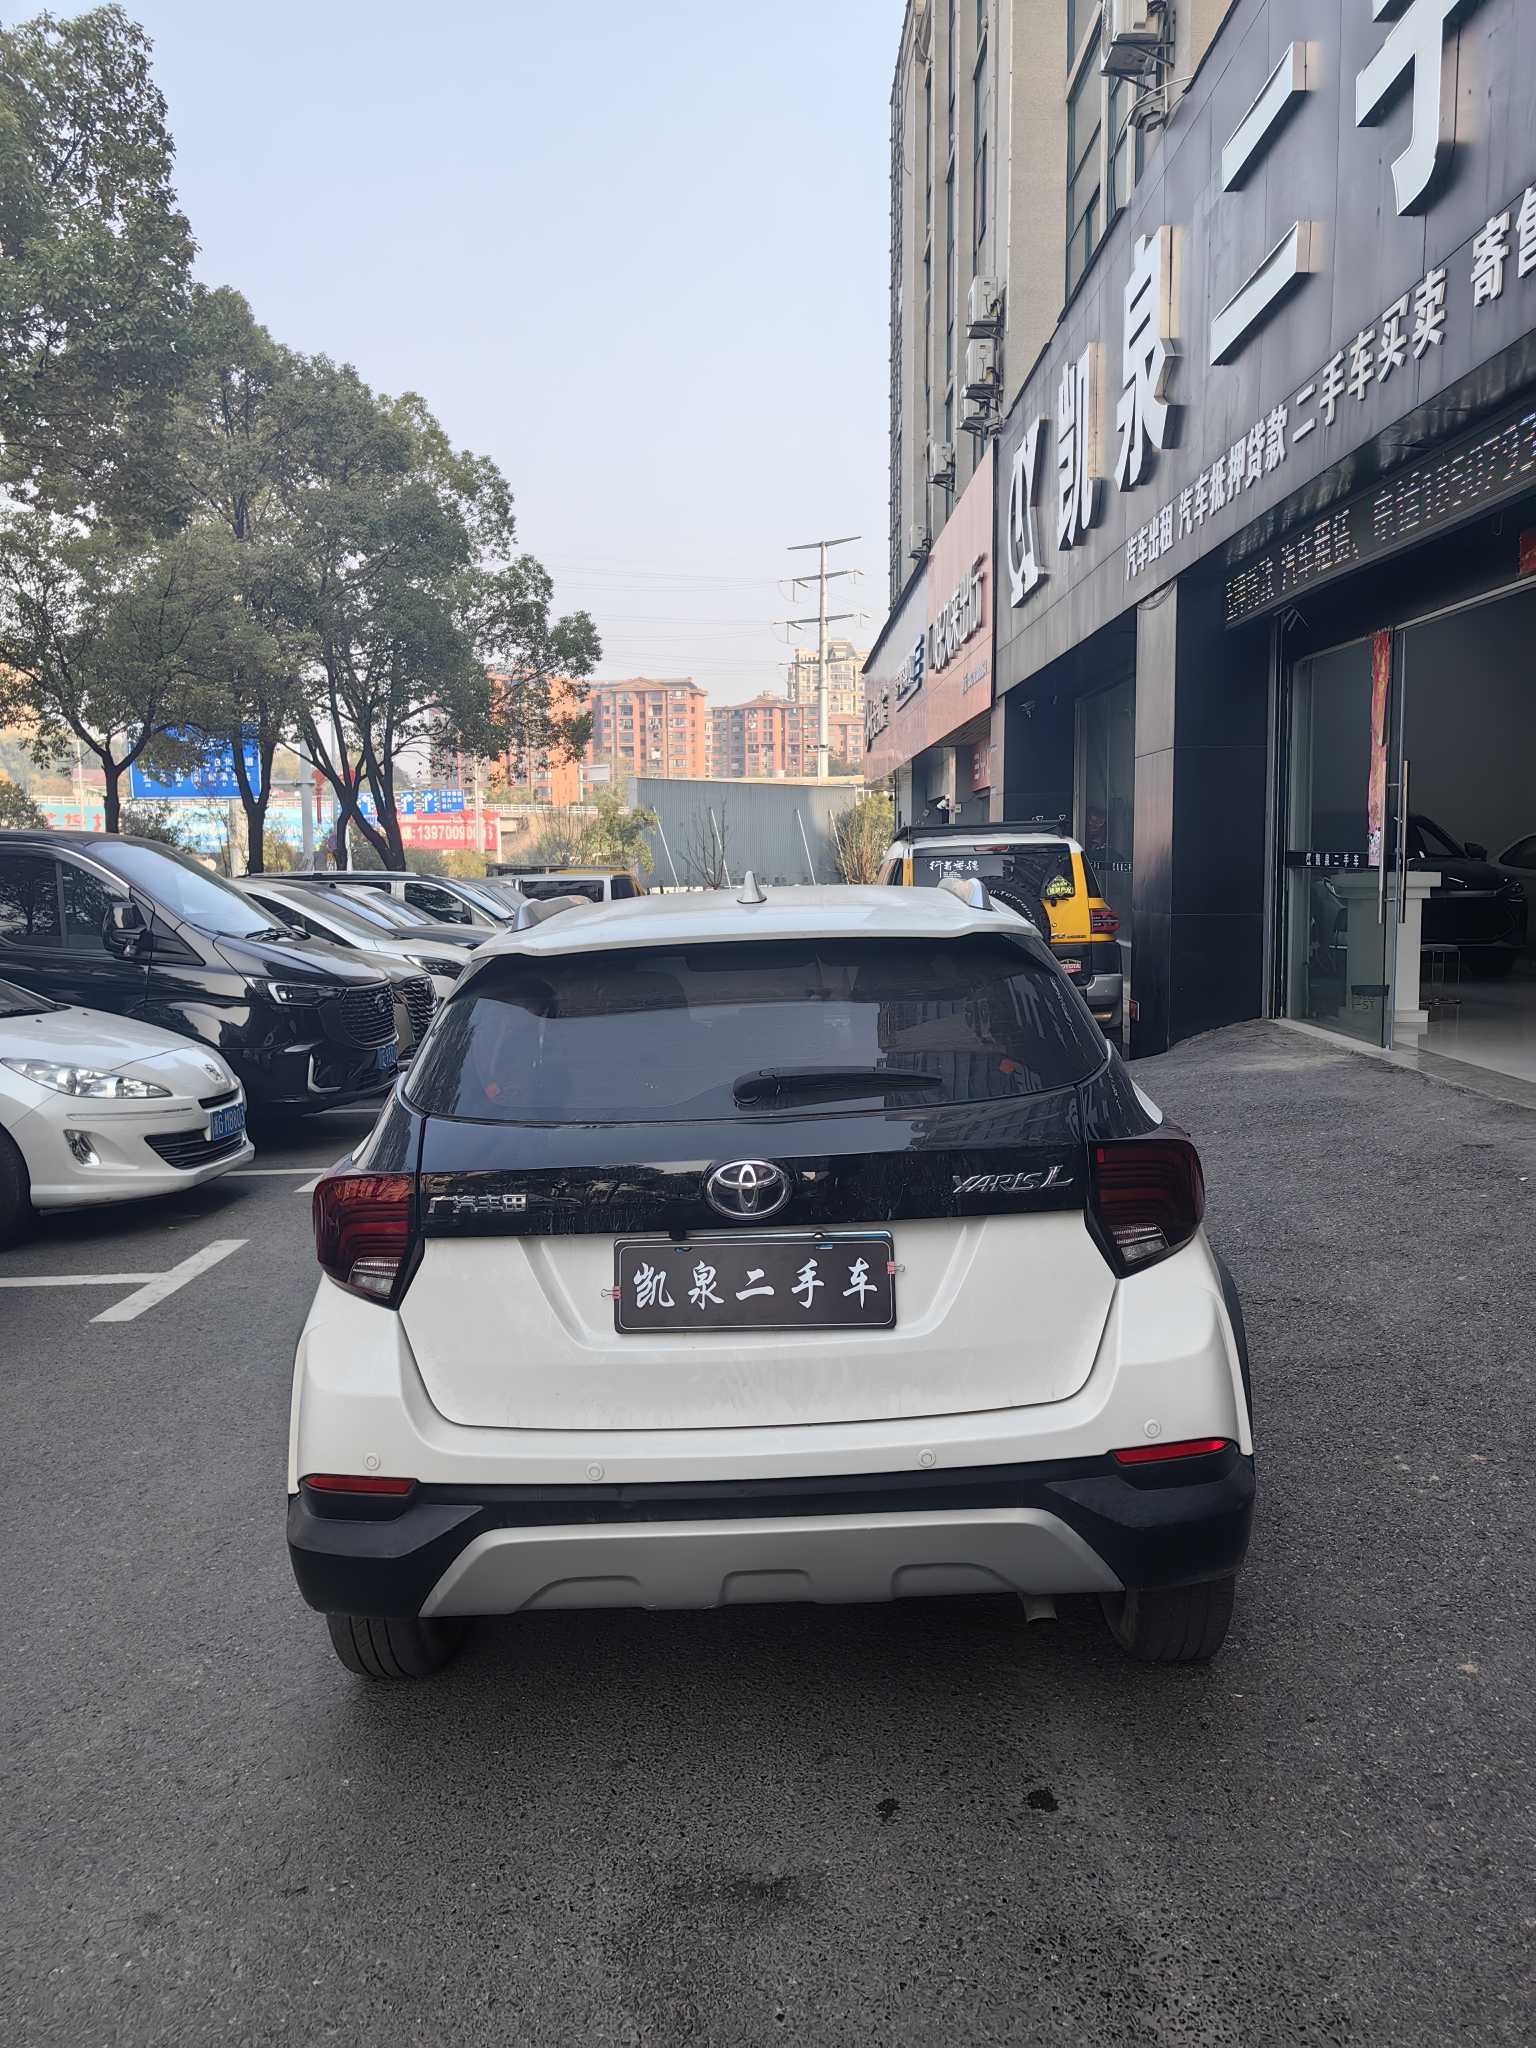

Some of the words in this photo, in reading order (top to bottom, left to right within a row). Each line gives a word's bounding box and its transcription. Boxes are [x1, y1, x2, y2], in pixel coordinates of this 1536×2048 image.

[1126, 503, 1175, 580] 汽车出租
[1178, 403, 1288, 540] 汽车抵押贷款
[1292, 267, 1448, 443] 二手车买卖
[1306, 852, 1359, 868] 泉二手车
[428, 1194, 527, 1214] 广汽丰田
[633, 1256, 878, 1311] 凯泉二手车
